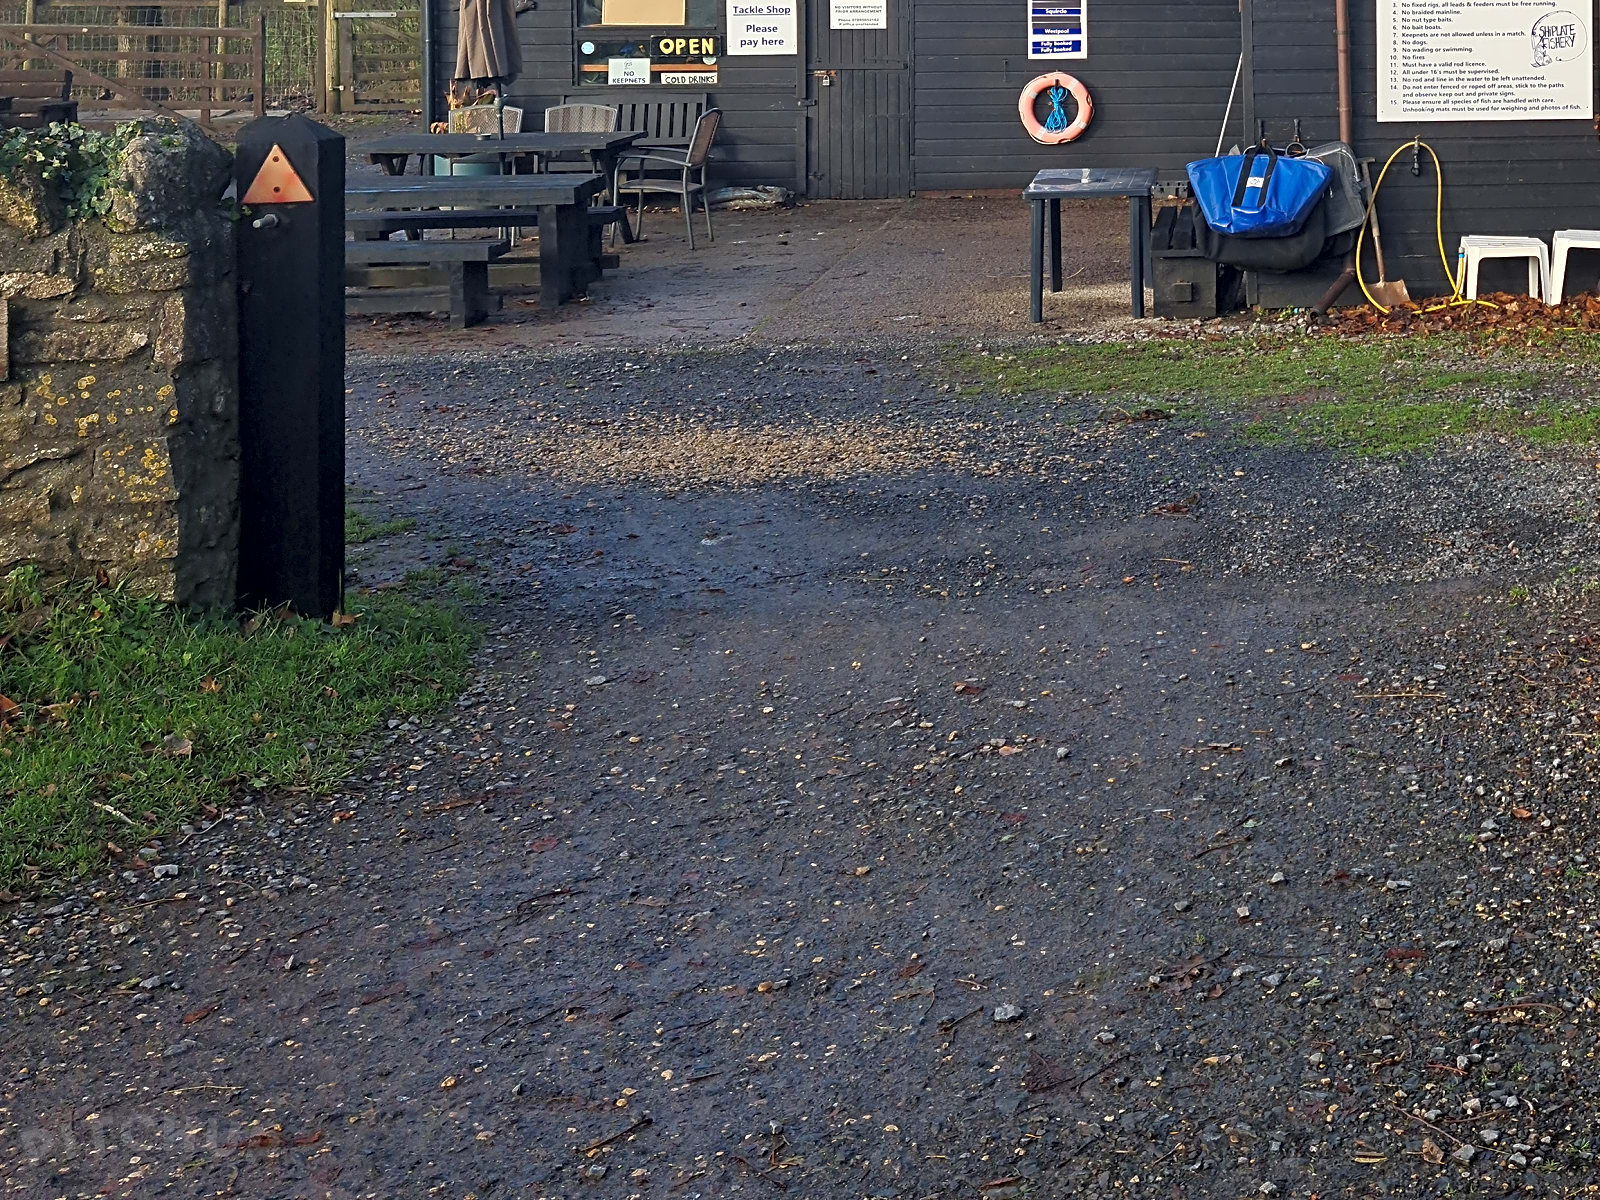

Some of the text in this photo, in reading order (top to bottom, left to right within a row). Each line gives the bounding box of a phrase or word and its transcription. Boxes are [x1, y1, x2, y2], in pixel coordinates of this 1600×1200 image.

[733, 5, 791, 15] Tackle Shop
[746, 24, 778, 32] Please
[659, 38, 714, 55] OPEN
[740, 37, 784, 48] pay here
